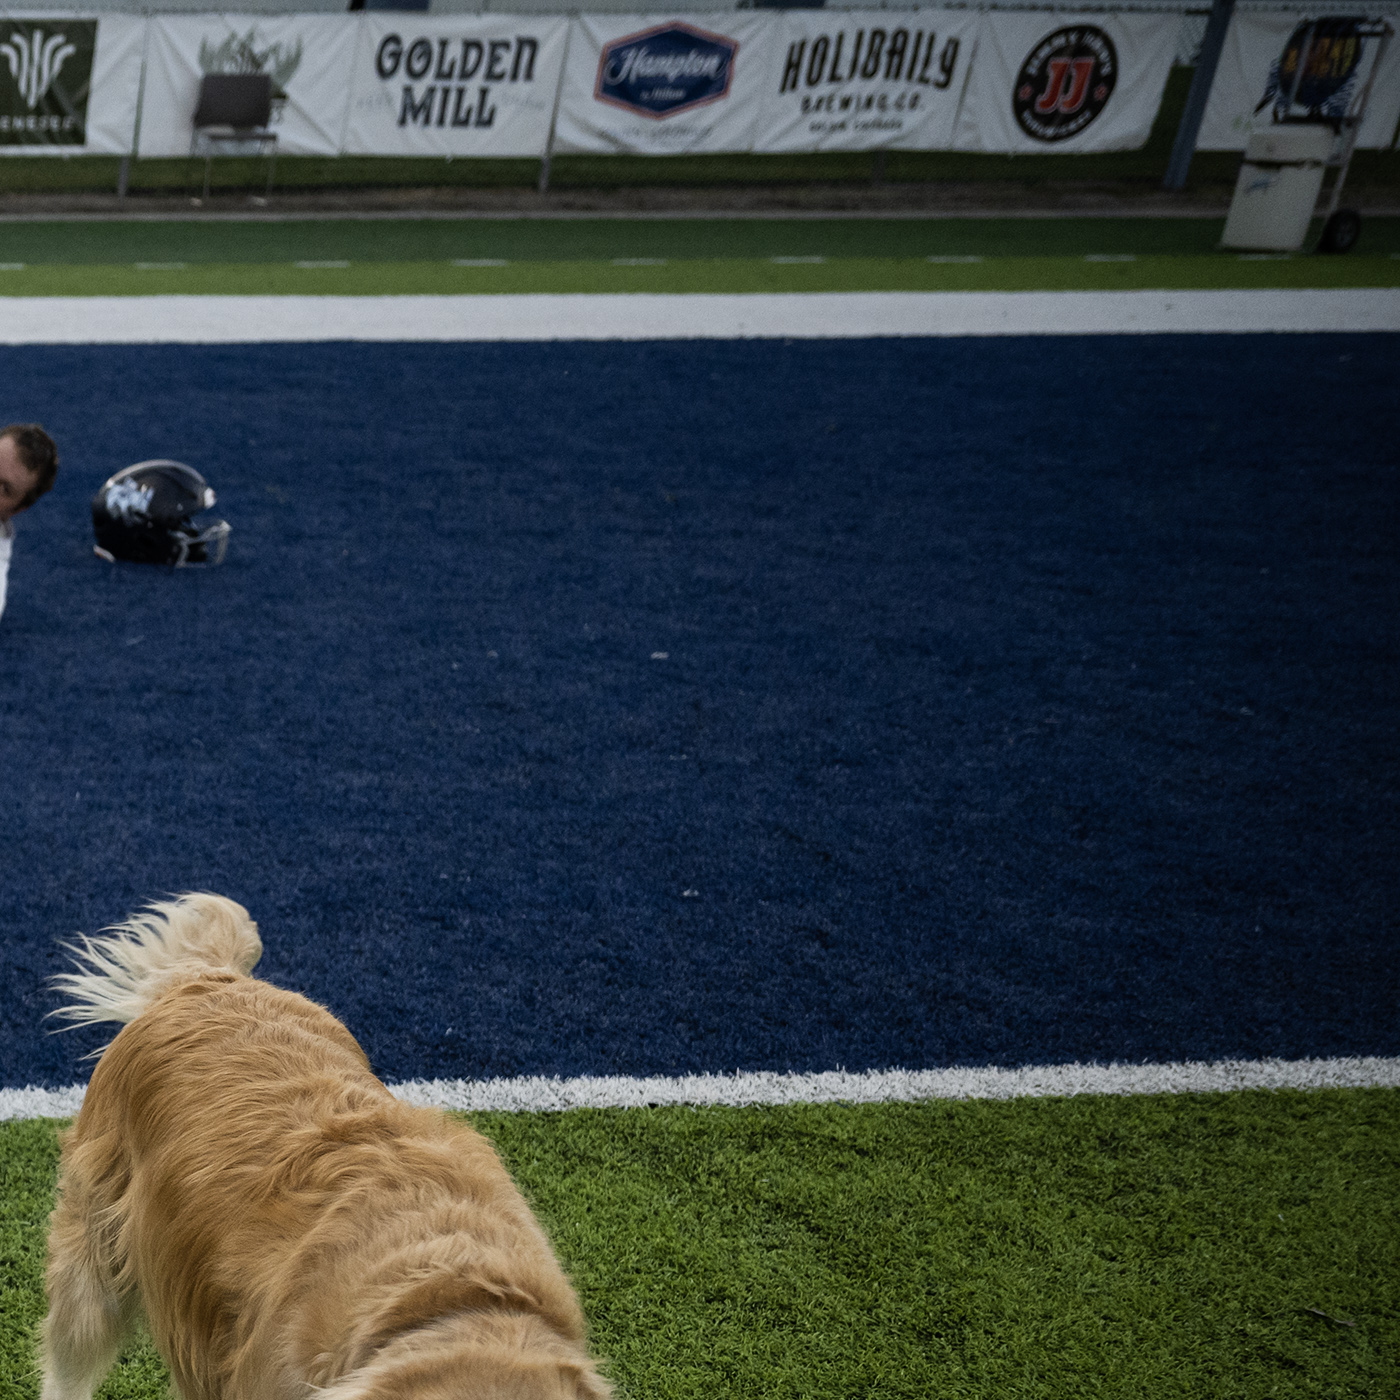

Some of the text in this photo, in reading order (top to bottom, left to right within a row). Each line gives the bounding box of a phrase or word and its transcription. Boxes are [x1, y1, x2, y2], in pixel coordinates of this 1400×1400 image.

[375, 33, 540, 82] GOLDEN
[604, 47, 730, 86] Hampton
[779, 28, 960, 94] HOLIDAILY
[397, 85, 498, 129] MILL
[801, 92, 890, 116] BREWING
